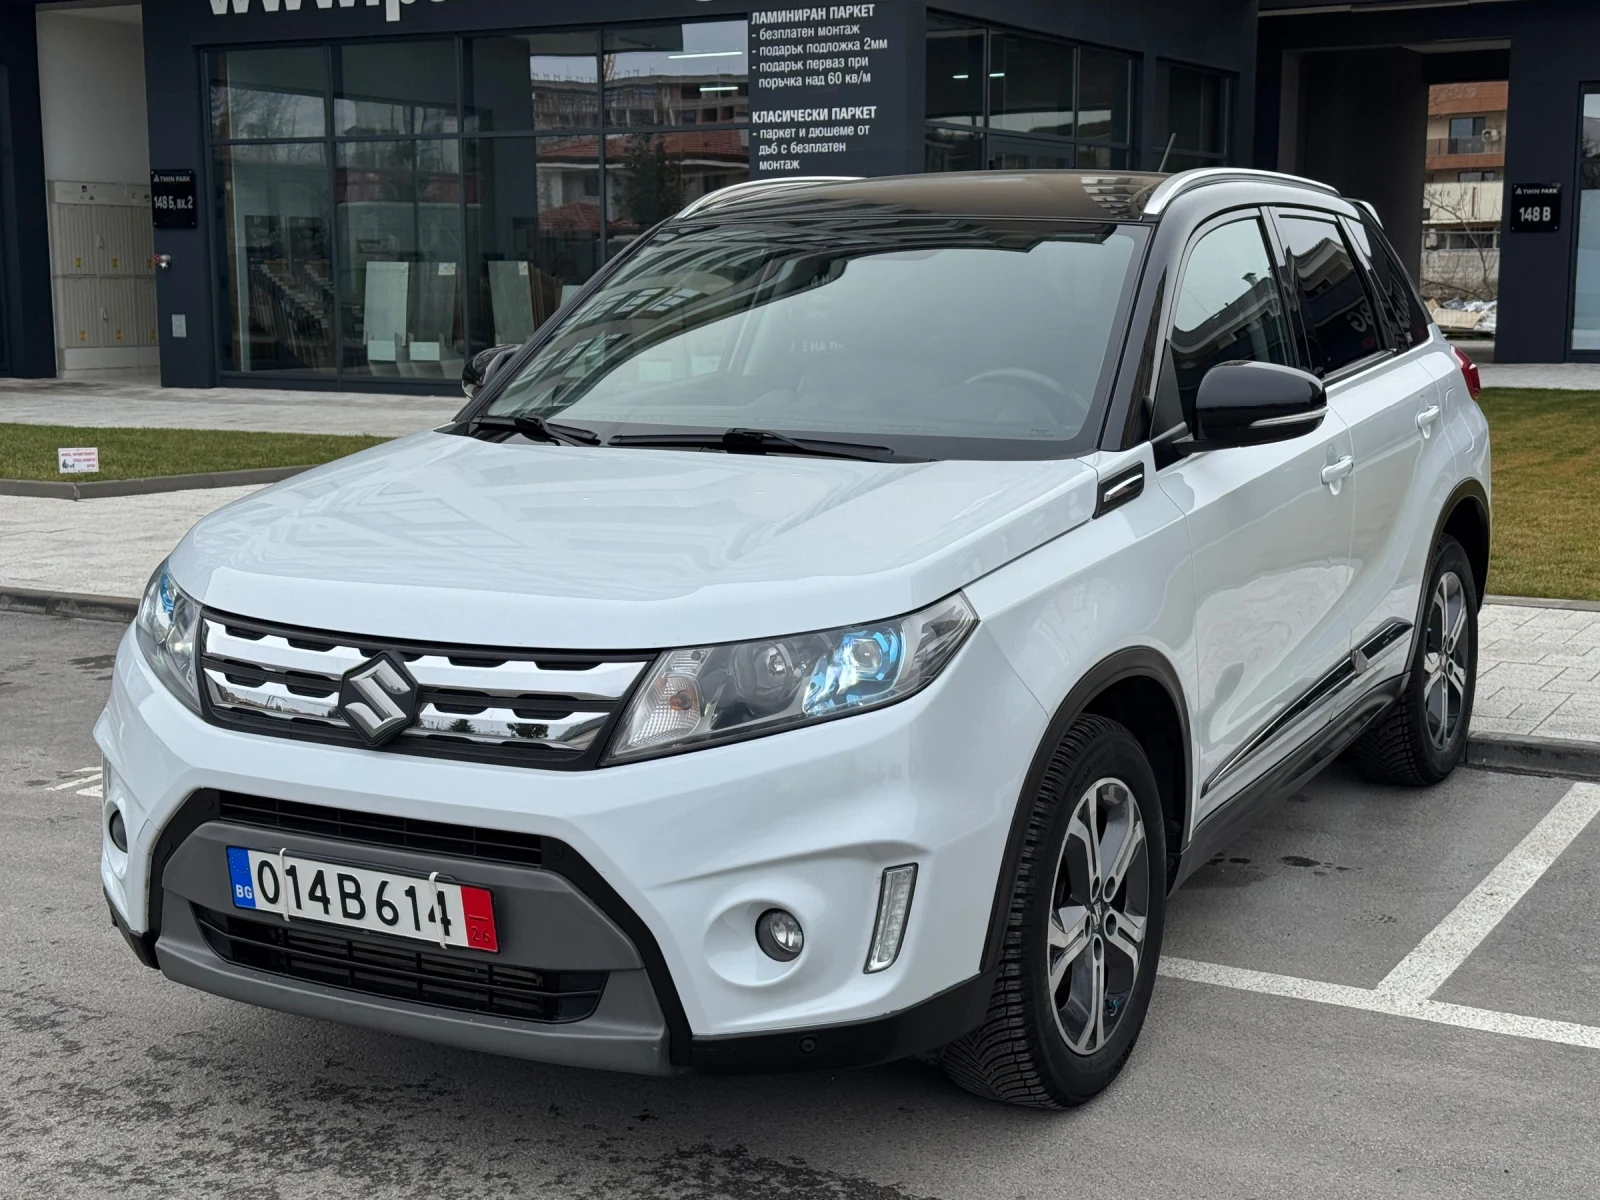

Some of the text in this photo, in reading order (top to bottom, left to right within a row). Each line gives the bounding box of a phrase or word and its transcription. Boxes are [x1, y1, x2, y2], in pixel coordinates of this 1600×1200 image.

[751, 4, 875, 25] ЛАМИНИРАН ПАРКЕТ
[760, 27, 815, 40] безплатен
[818, 24, 860, 37] монтаж
[760, 44, 804, 57] подарък
[806, 40, 861, 54] подложка
[863, 37, 888, 50] 2мм
[760, 60, 804, 73] подарък
[806, 57, 845, 72] перваз
[848, 56, 869, 69] при
[758, 70, 871, 90] поръчка над 60 кв/м
[752, 106, 877, 123] КЛАСИЧЕСКИ ПАРКЕТ
[760, 128, 796, 141] паркет
[799, 129, 806, 137] и
[808, 125, 855, 138] дюшеме
[857, 125, 870, 135] от
[758, 141, 846, 156] дъб с безплатен
[759, 160, 800, 170] монтаж
[1519, 206, 1541, 222] 148
[235, 884, 253, 900] BG
[471, 926, 491, 944] 26
